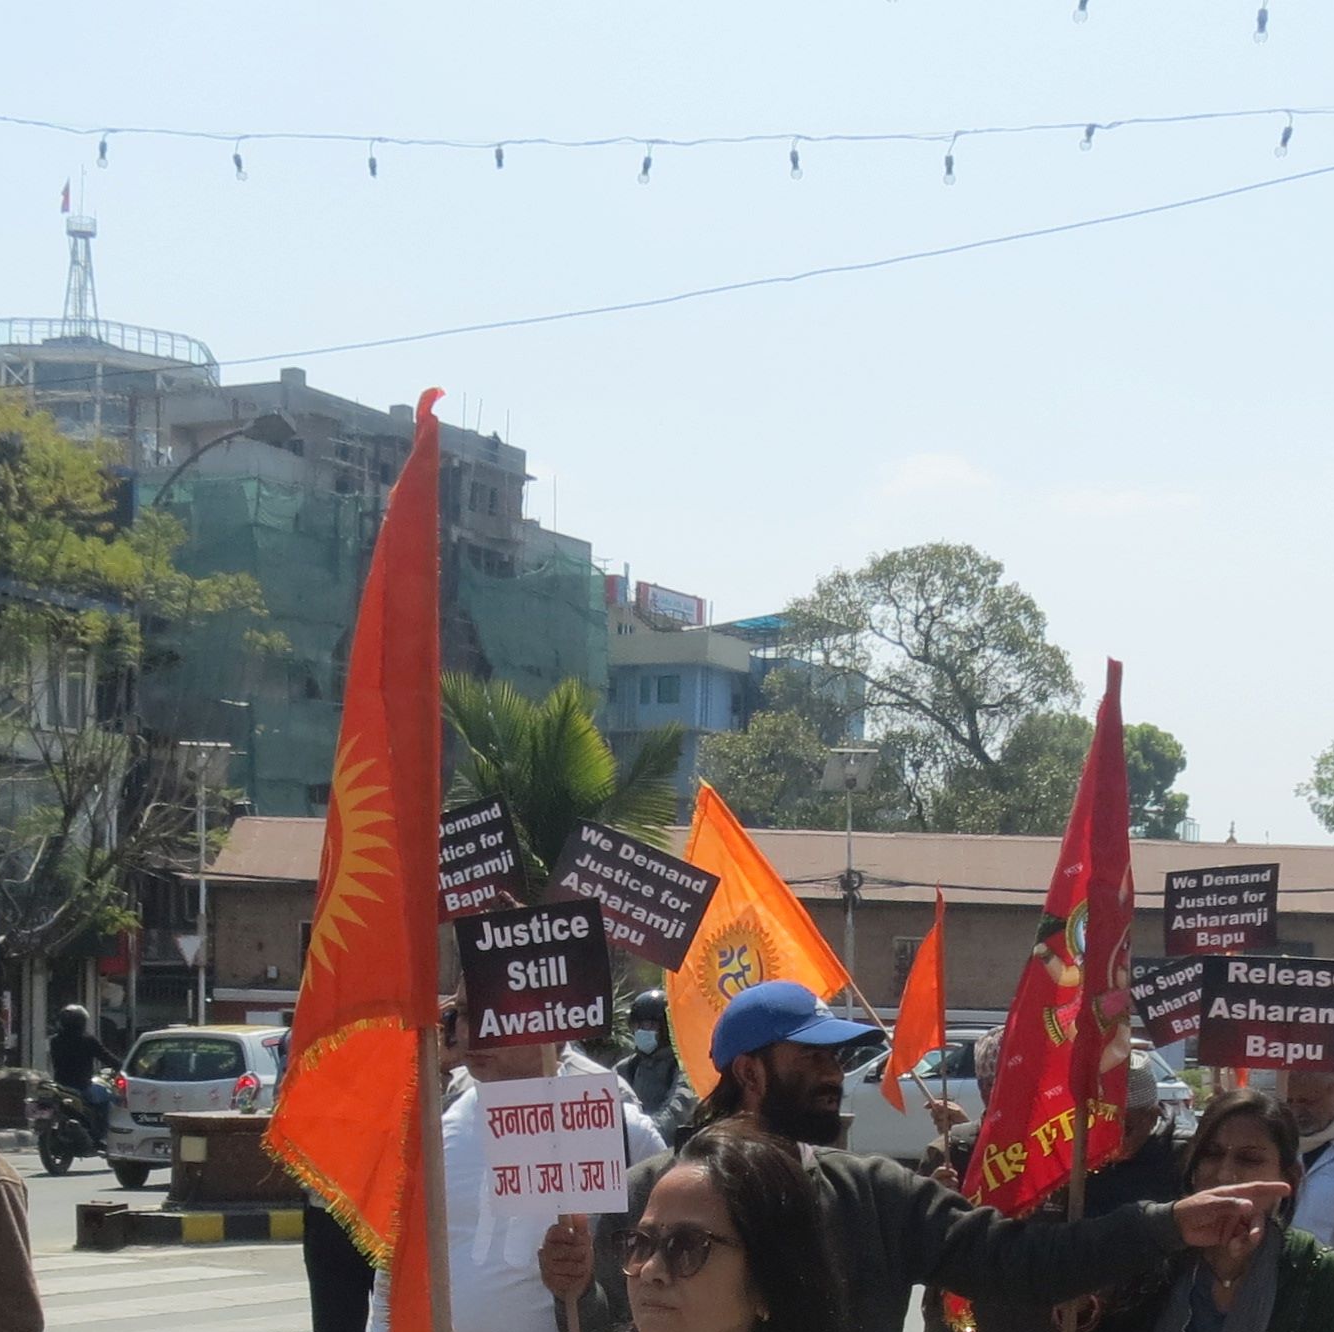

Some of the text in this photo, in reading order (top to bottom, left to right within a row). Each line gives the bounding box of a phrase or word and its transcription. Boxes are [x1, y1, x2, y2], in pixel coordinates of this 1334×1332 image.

[479, 829, 505, 850] for
[438, 849, 515, 892] haramji
[581, 825, 708, 894] We Demand
[575, 853, 692, 914] Justice for
[1172, 869, 1271, 890] We Demand
[444, 883, 496, 912] Bapu
[560, 871, 688, 940] Asharamji
[1175, 890, 1267, 910] Justice for
[475, 912, 590, 951] Justice
[602, 916, 646, 947] apu
[1171, 907, 1269, 931] Asharamji
[1196, 931, 1245, 949] Bapu
[507, 955, 568, 991] Still
[1130, 981, 1155, 1001] We
[479, 996, 605, 1039] Awaited
[1245, 1034, 1324, 1065] Bapu
[487, 1088, 615, 1138] सनातन धर्मको
